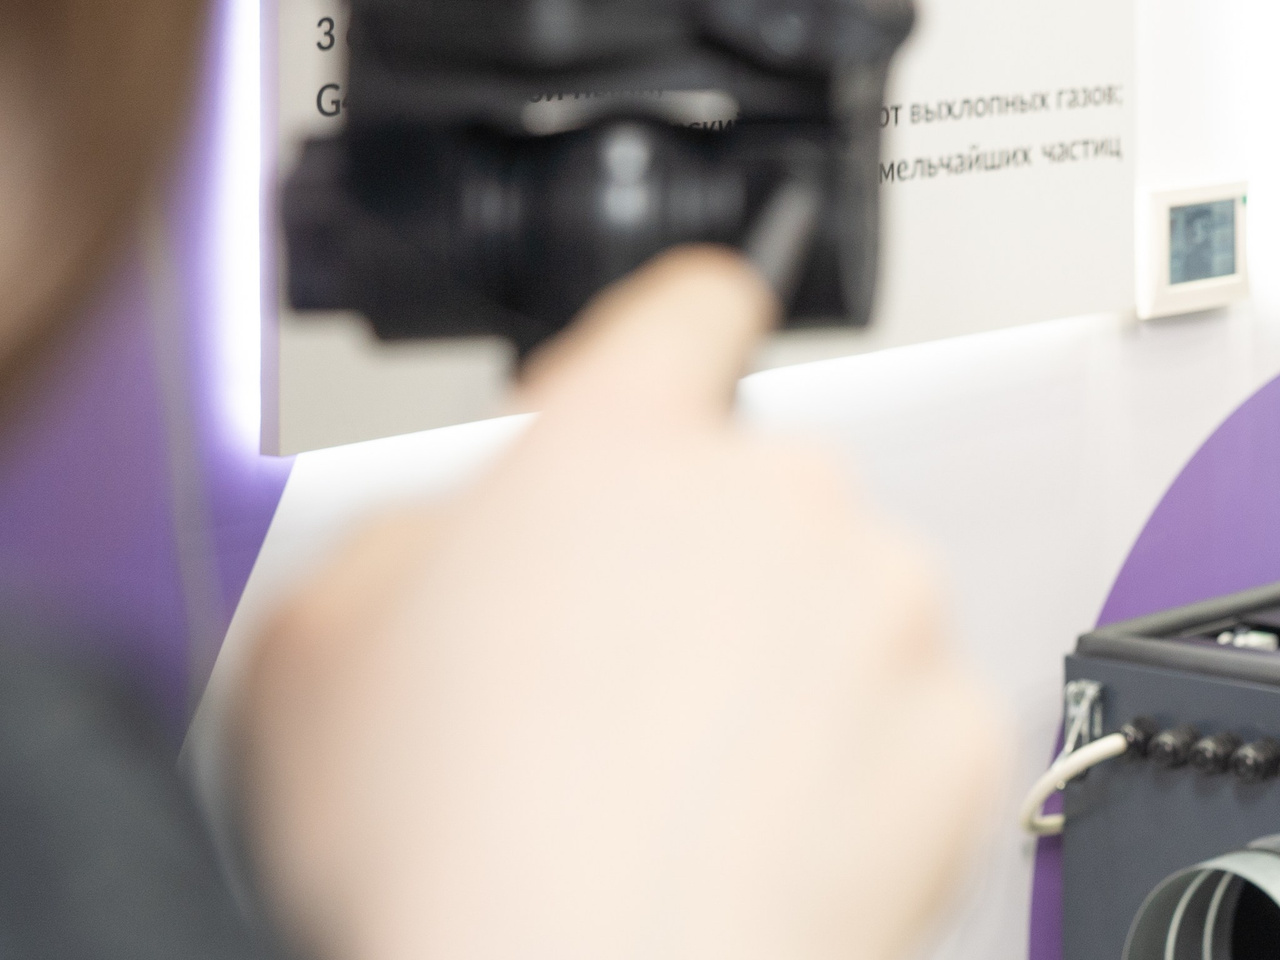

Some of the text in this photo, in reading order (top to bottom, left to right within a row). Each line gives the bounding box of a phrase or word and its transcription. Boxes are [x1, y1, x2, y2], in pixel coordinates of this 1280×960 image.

[316, 16, 336, 52] 3
[316, 83, 347, 118] G
[879, 105, 902, 129] от
[909, 93, 1050, 125] выхлопных
[879, 135, 1123, 184] мельчайших частиц
